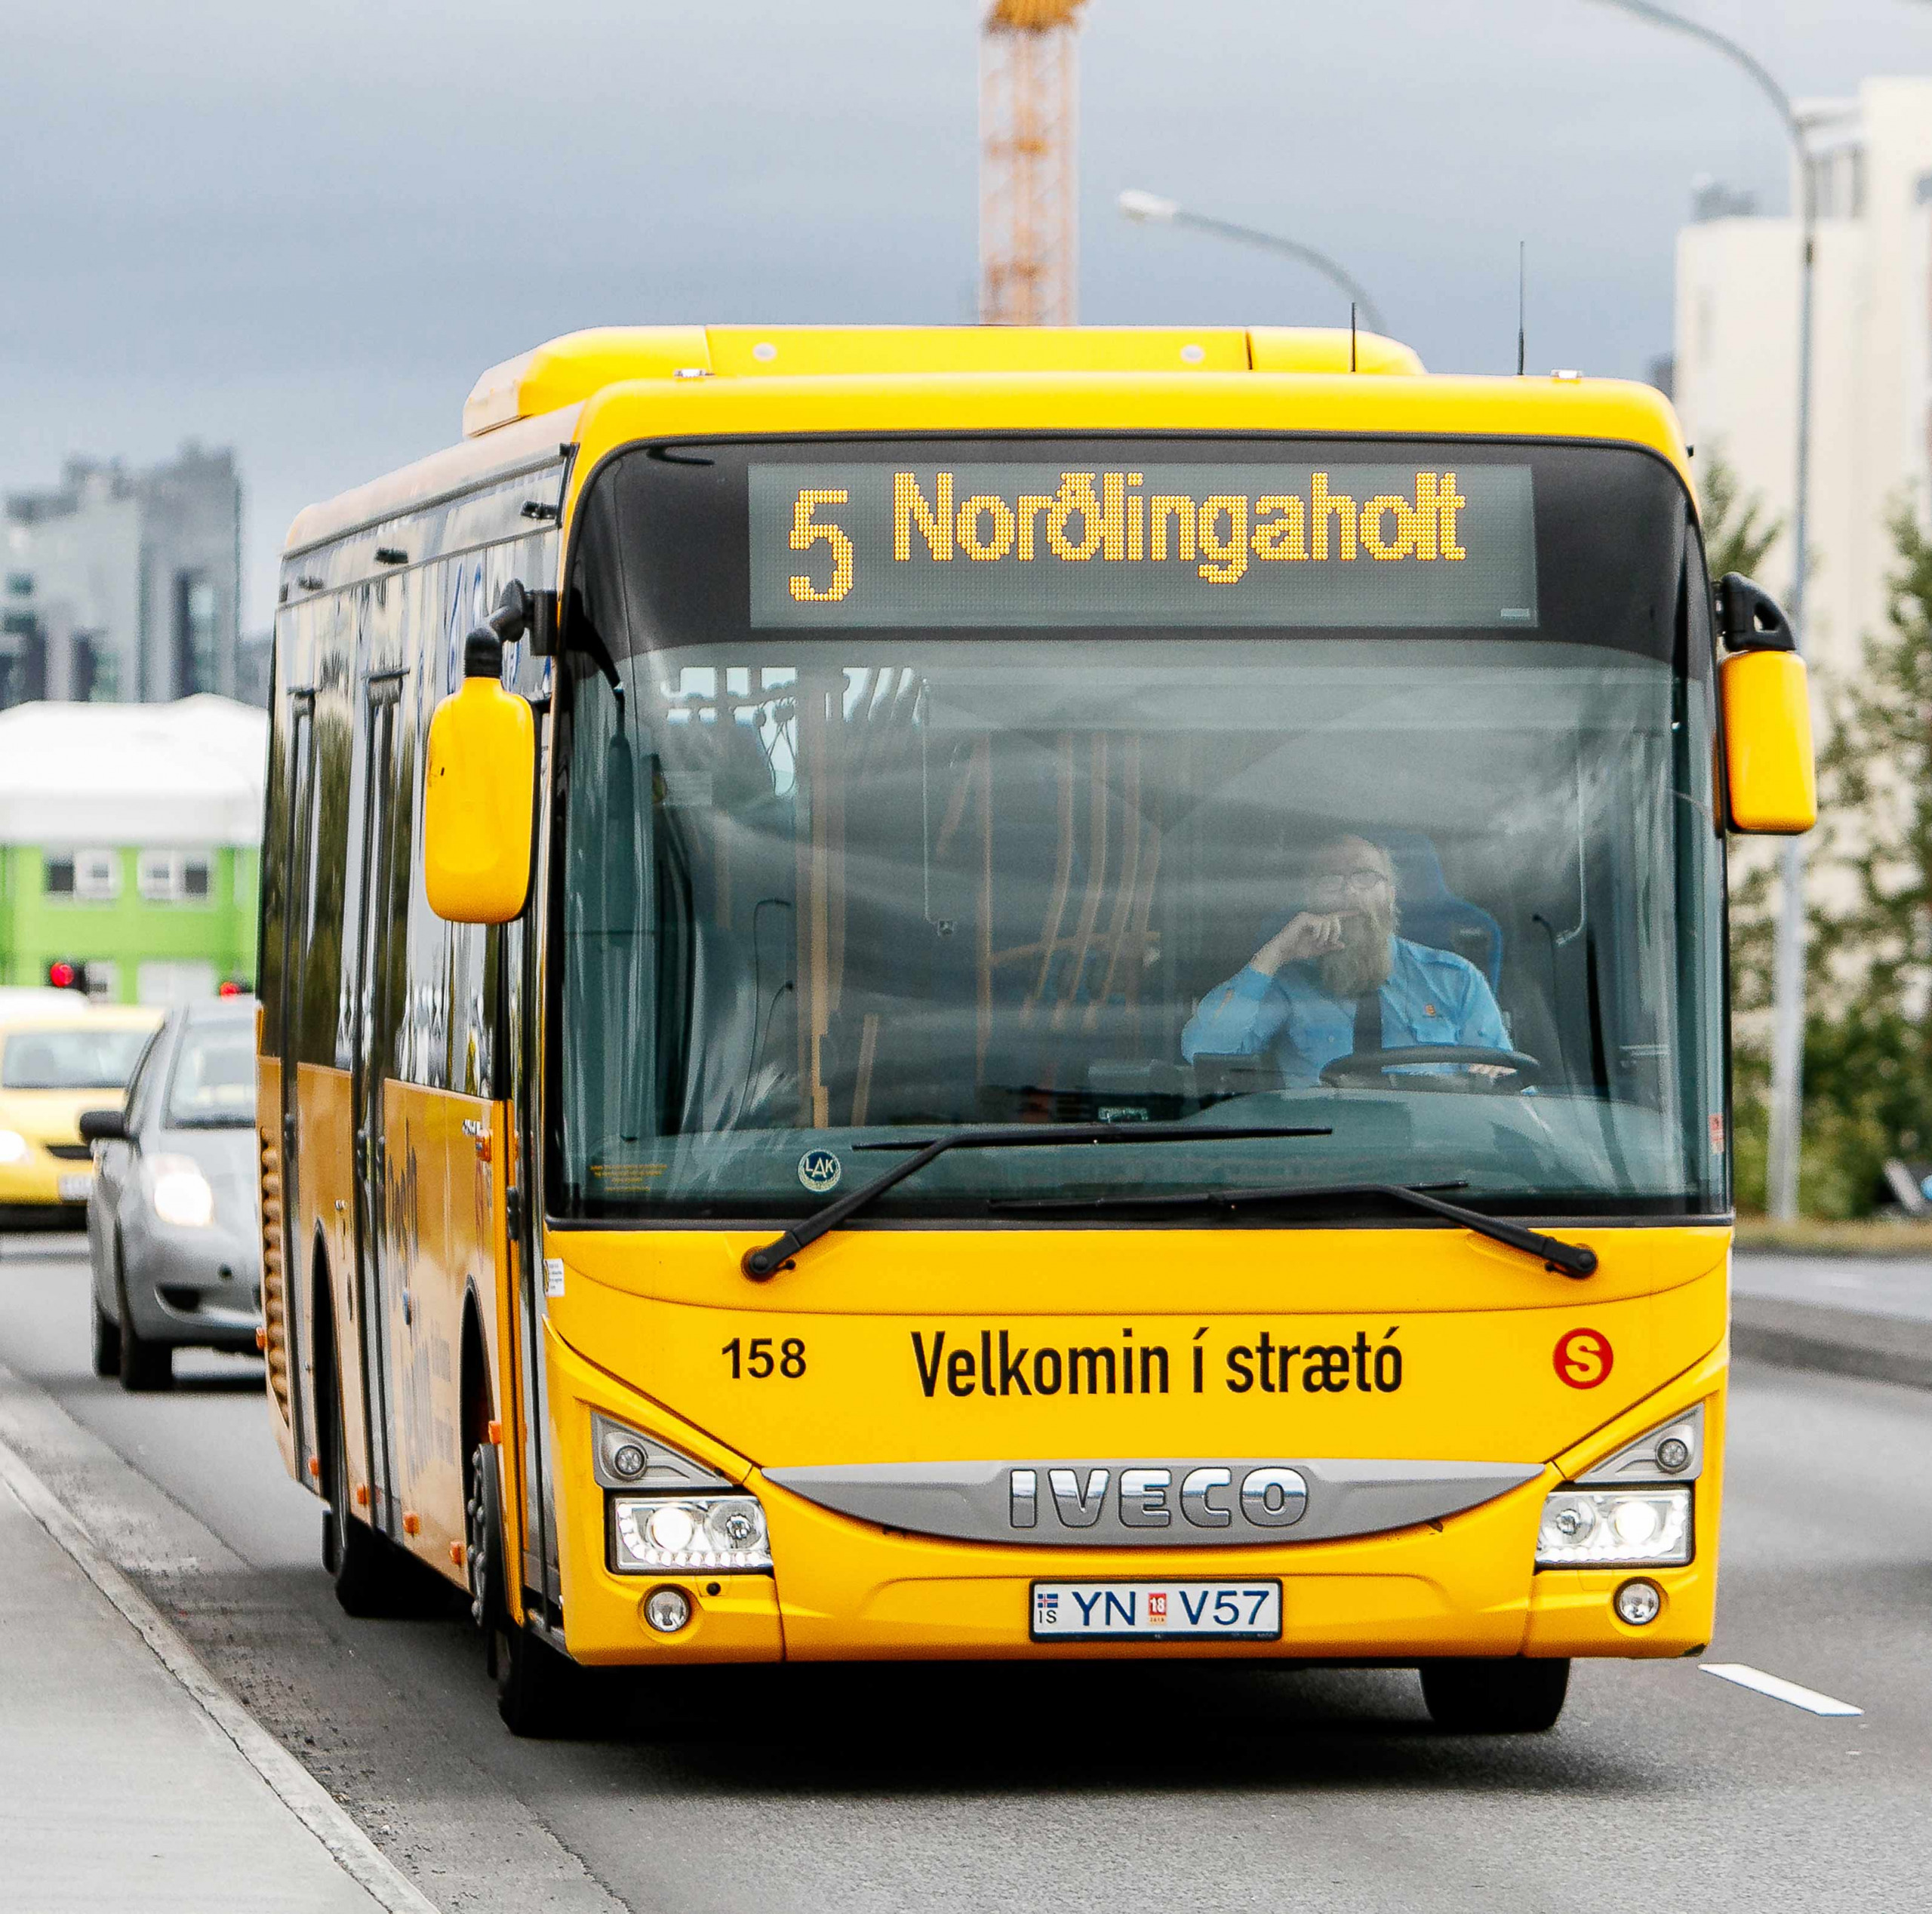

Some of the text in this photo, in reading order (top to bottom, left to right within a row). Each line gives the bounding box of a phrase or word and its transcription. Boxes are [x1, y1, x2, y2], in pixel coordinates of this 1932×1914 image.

[789, 472, 1466, 602] 5 Norðlingaholt
[805, 1157, 834, 1178] LAK
[721, 1337, 807, 1379] 158
[910, 1325, 1402, 1398] Velkomin í strætó
[1564, 1334, 1603, 1383] S
[1008, 1466, 1309, 1528] IVECO
[1038, 1610, 1057, 1624] IS
[1071, 1589, 1270, 1626] YN V57
[1149, 1596, 1165, 1613] 18
